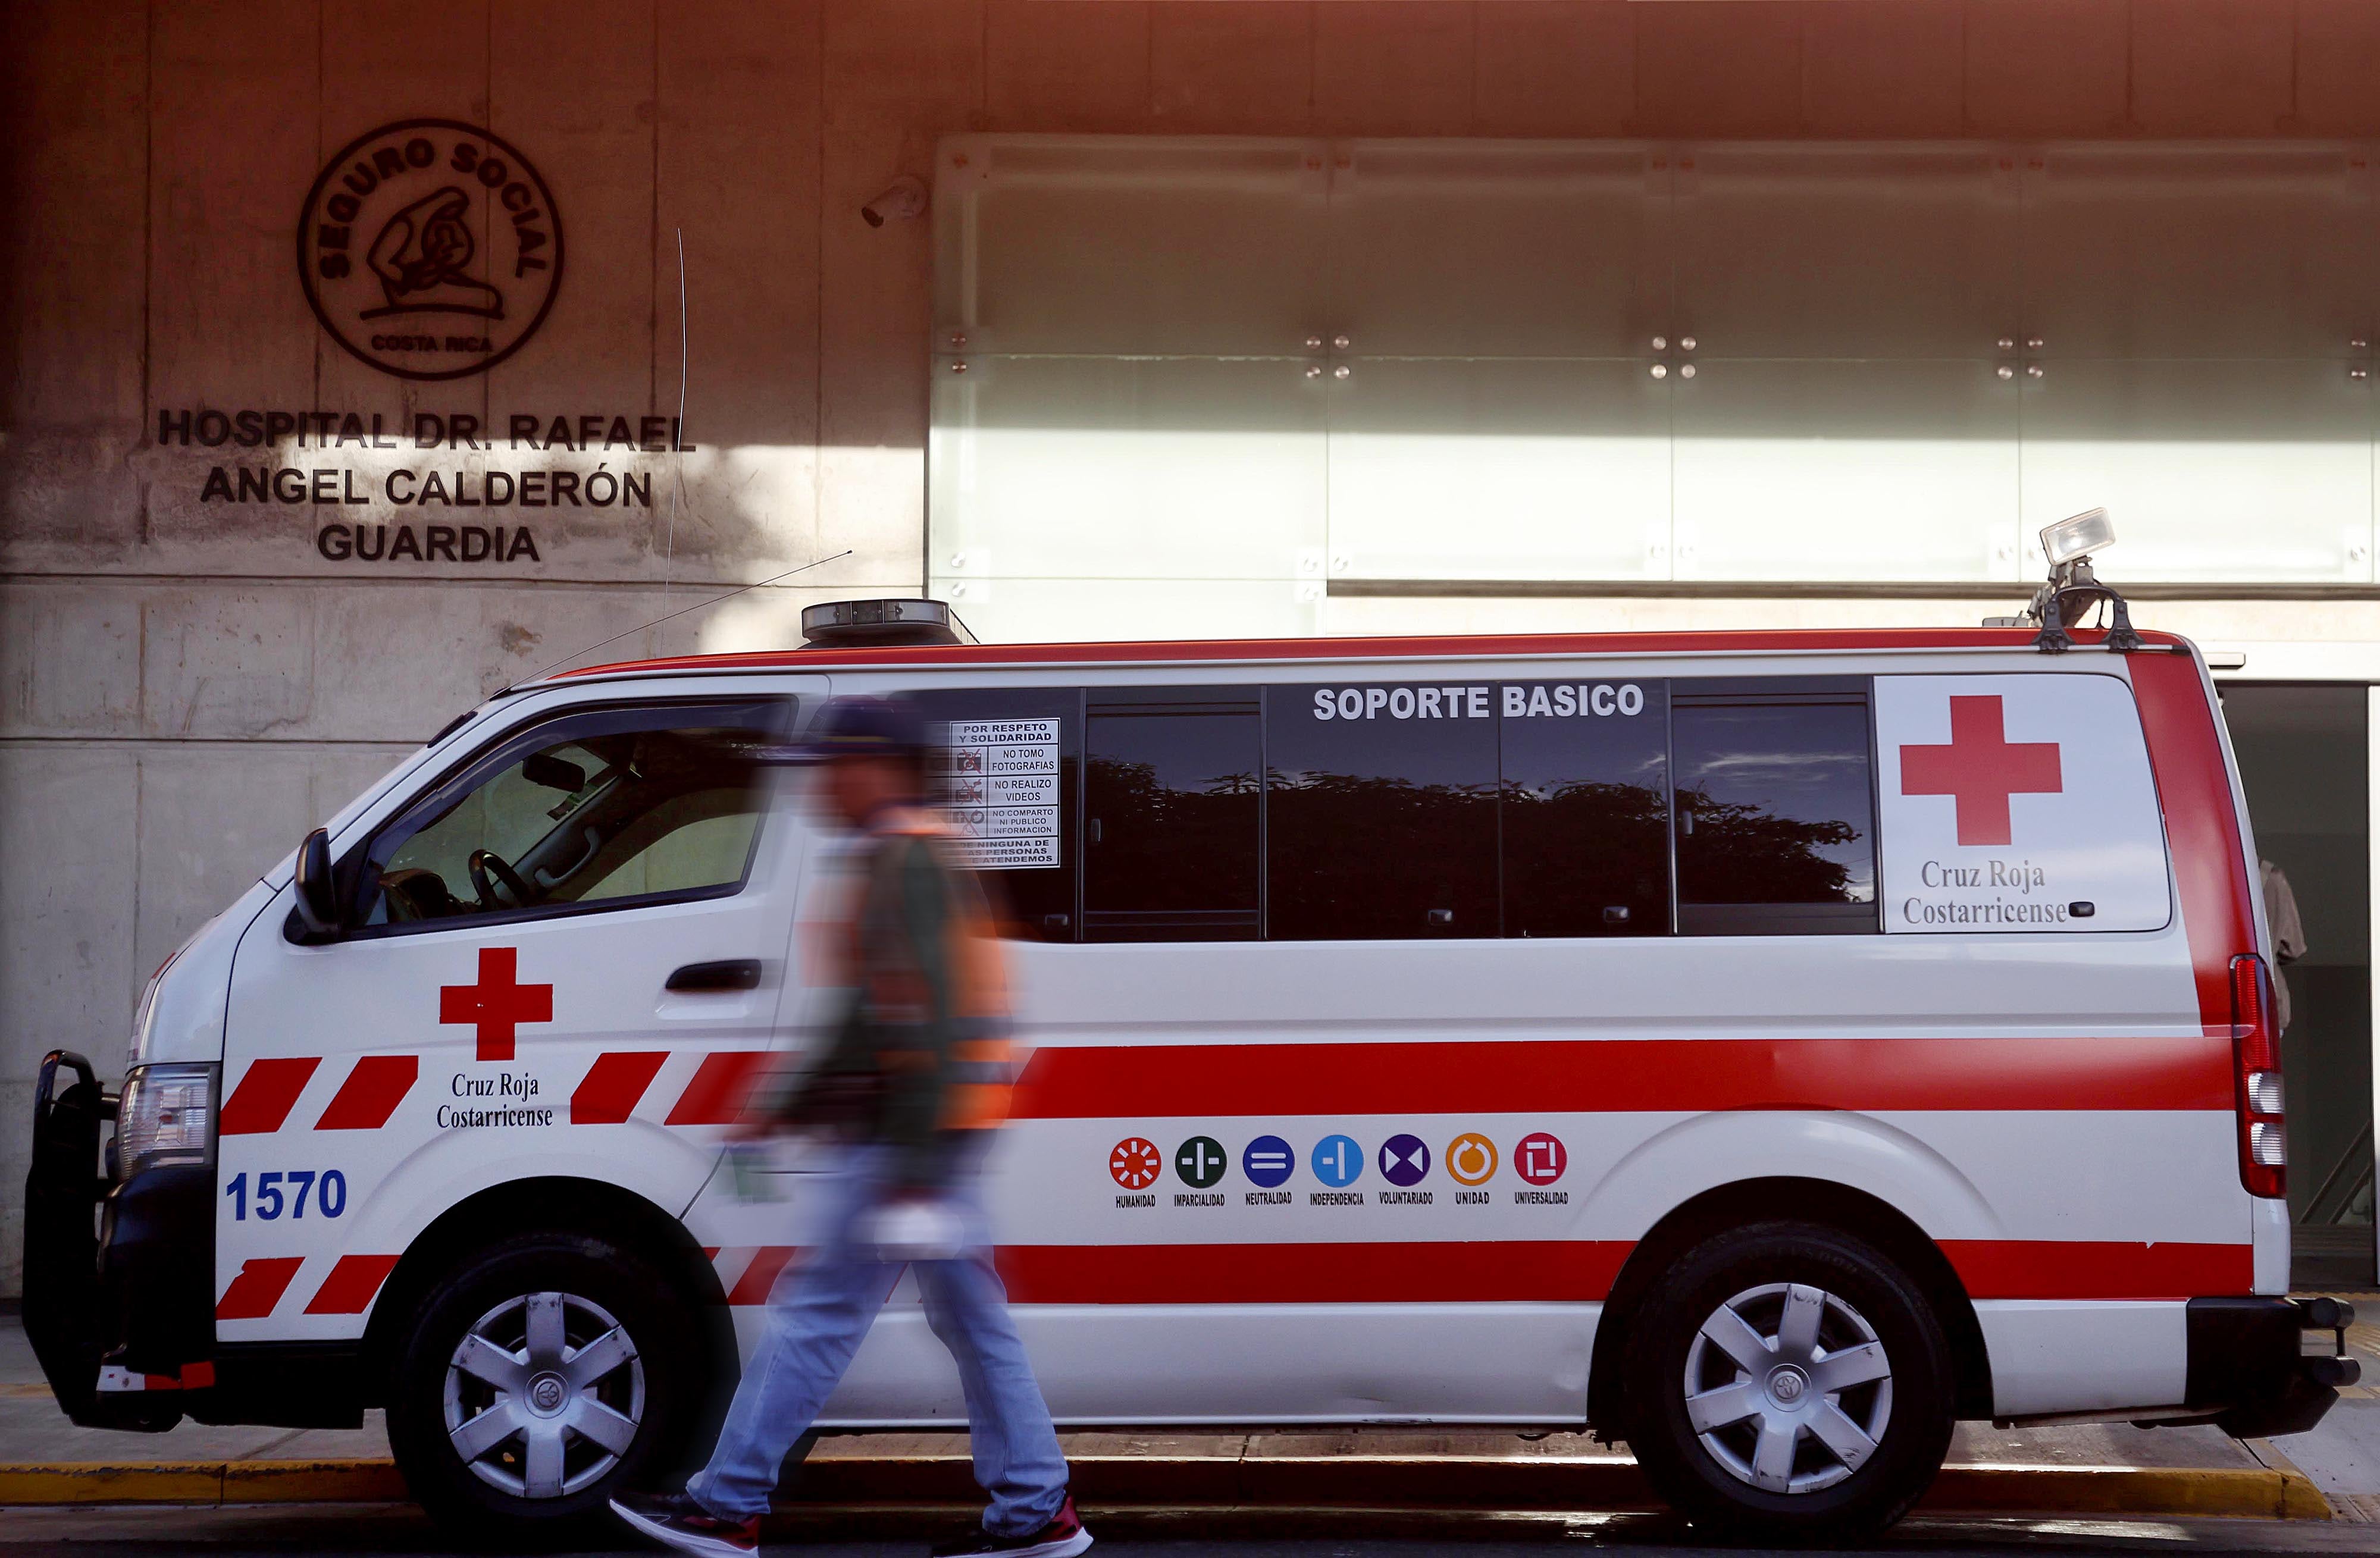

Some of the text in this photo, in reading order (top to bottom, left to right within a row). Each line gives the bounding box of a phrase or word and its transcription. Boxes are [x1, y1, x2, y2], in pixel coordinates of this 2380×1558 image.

[318, 137, 546, 279] SEGURO SOCIAL
[371, 334, 493, 353] COSTA RICA
[158, 409, 696, 453] HOSPITAL DR. RAFAEL
[200, 463, 652, 507] ANGEL CALDERÓN
[317, 524, 540, 562] GUARDIA
[1313, 684, 1644, 720] SOPORTE BASICO
[963, 723, 1048, 733] POR RESPETO
[970, 733, 1052, 742] SOLIDARIDAD
[1003, 748, 1044, 758] NO TOMO
[992, 761, 1054, 771] FOTOGRAFIAS
[995, 779, 1051, 789] NO REALIZO
[1006, 792, 1041, 801] VIDEOS
[977, 840, 1032, 848] NINGUNA
[986, 848, 1047, 856] PERSONAS
[982, 855, 1053, 864] ATENDEMOS
[1921, 860, 2046, 894] Cruz Roja
[1904, 896, 2067, 924] Costarricense
[452, 1072, 539, 1102] Cruz Roja
[436, 1104, 553, 1129] Costarricense
[226, 1170, 347, 1221] 1570
[1116, 1194, 1156, 1209] HUMANIDAD
[1174, 1193, 1226, 1208] IMPARCIALIDAD
[1245, 1192, 1292, 1206] NEUTRALIDAD
[1310, 1192, 1364, 1206] INDEPENDENCIA
[1379, 1191, 1434, 1205] VOLUNTARIADO
[1455, 1192, 1490, 1205] UNIDAD
[1514, 1191, 1569, 1205] UNIVERSALIDAD
